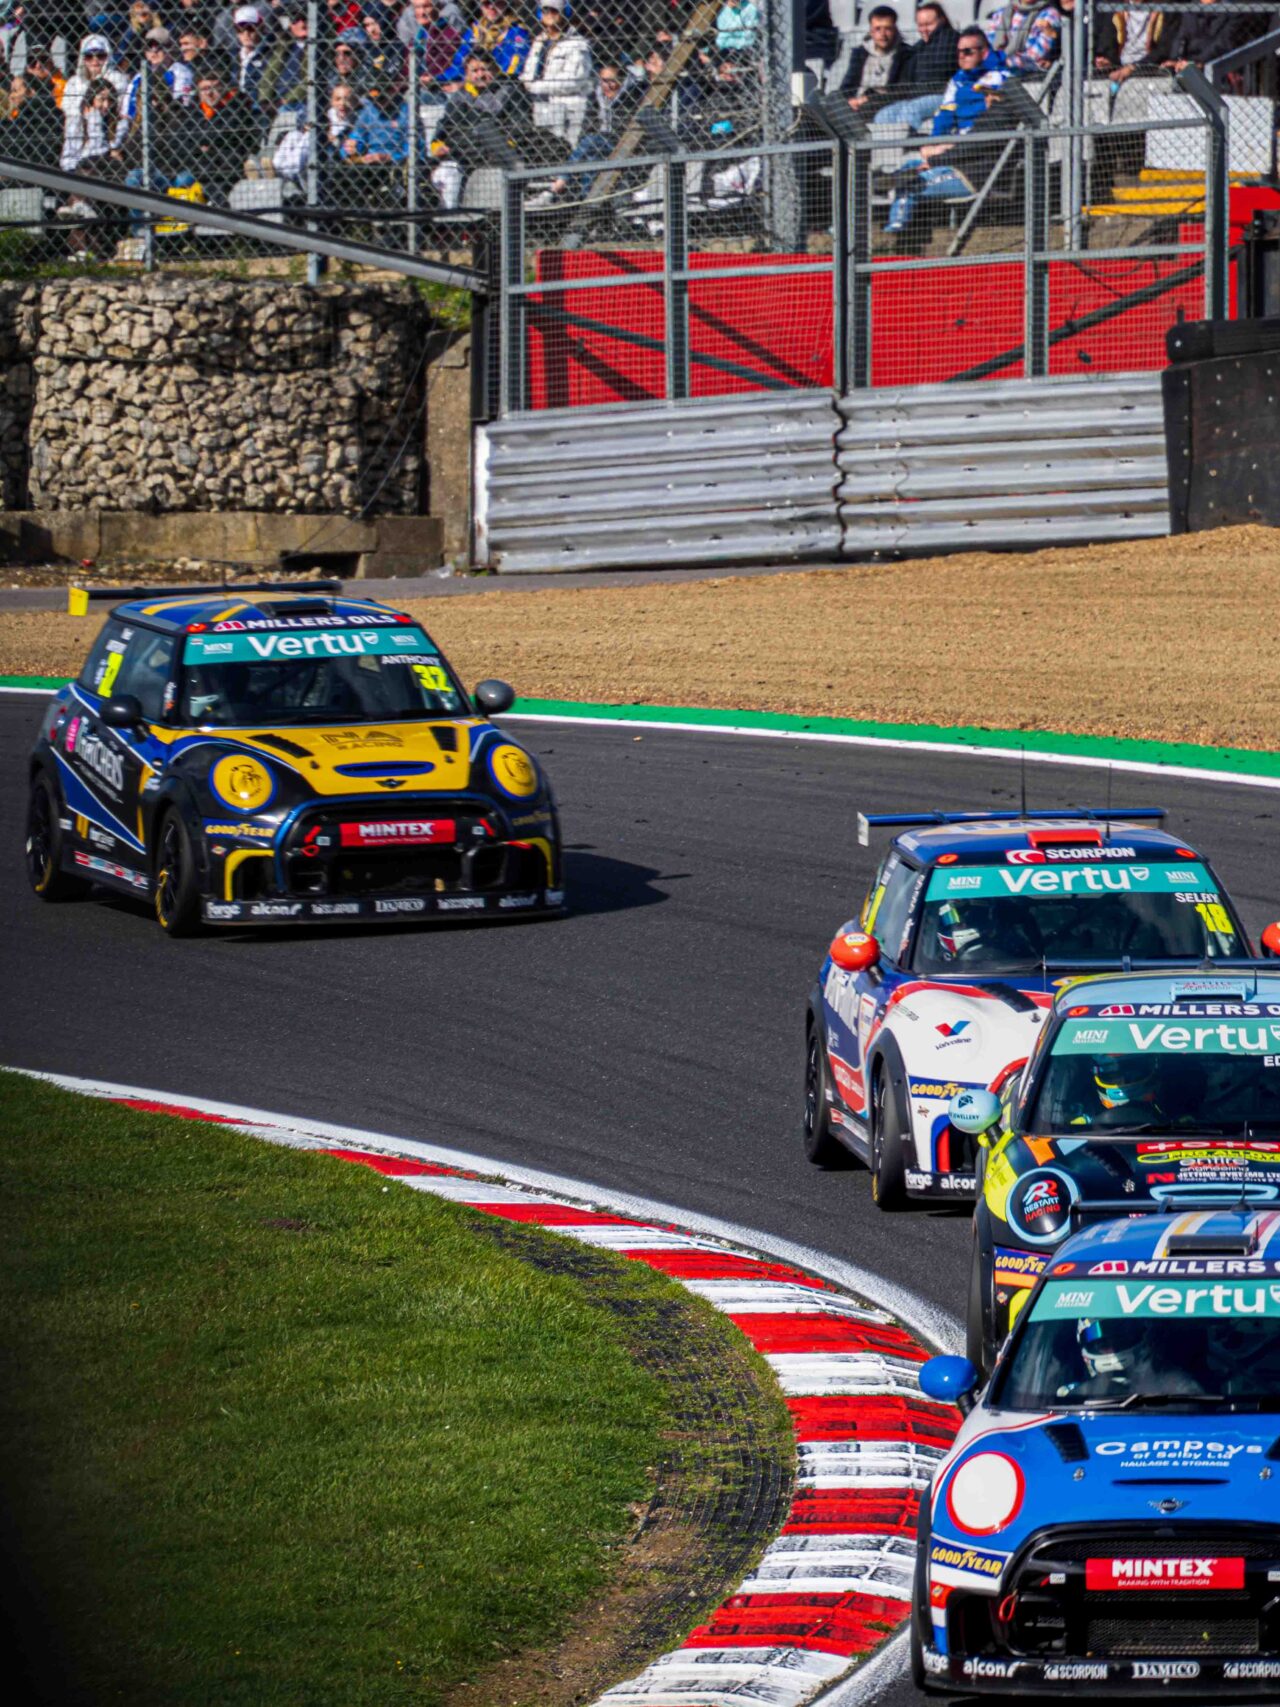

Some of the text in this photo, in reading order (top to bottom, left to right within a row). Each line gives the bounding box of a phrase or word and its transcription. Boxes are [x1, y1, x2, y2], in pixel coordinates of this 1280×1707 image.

[245, 614, 396, 630] MILLERS OILS
[247, 633, 365, 657] Vertu
[412, 664, 453, 692] 32
[358, 822, 436, 837] MINTEX
[1046, 847, 1136, 860] SCORPION
[949, 876, 982, 887] MINI
[999, 867, 1131, 893] Vertu
[1165, 871, 1197, 881] MINI
[1175, 892, 1219, 903] SELBY
[1195, 903, 1234, 934] 18
[1138, 1005, 1260, 1016] MILLERS
[1074, 1029, 1109, 1039] MINI
[1128, 1023, 1268, 1050] Vertu
[1024, 1197, 1059, 1214] RESTART
[1025, 1204, 1061, 1223] RACING
[1132, 1261, 1266, 1273] MILLERS
[1058, 1292, 1094, 1302] MINI
[1115, 1285, 1266, 1314] Vertu
[1095, 1440, 1263, 1459] Campeys
[1156, 1451, 1202, 1460] Selby
[931, 1546, 1003, 1575] GOODYEAR
[1112, 1559, 1214, 1577] MINTEX
[963, 1657, 1006, 1678] alcon
[1059, 1664, 1108, 1679] SCORPION
[1131, 1662, 1199, 1678] DAMICO
